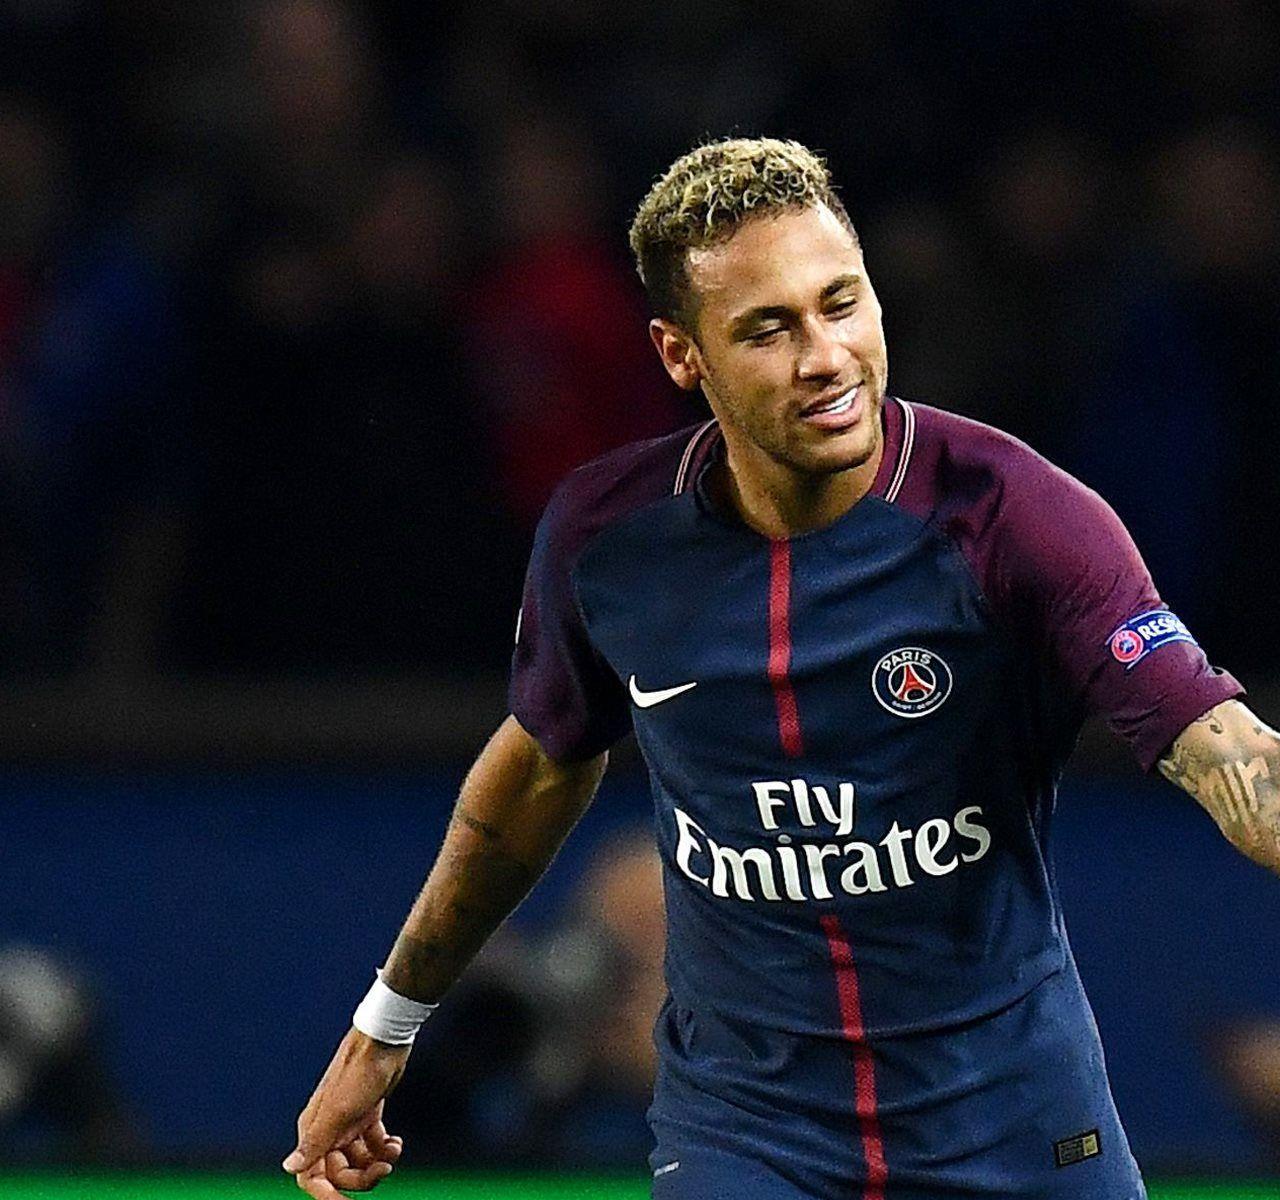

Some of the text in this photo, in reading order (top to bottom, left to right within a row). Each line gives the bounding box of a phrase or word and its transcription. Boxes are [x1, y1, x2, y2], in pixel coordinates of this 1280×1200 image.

[881, 651, 932, 672] PARIS
[751, 778, 855, 836] Fly
[673, 805, 992, 902] Emirates
